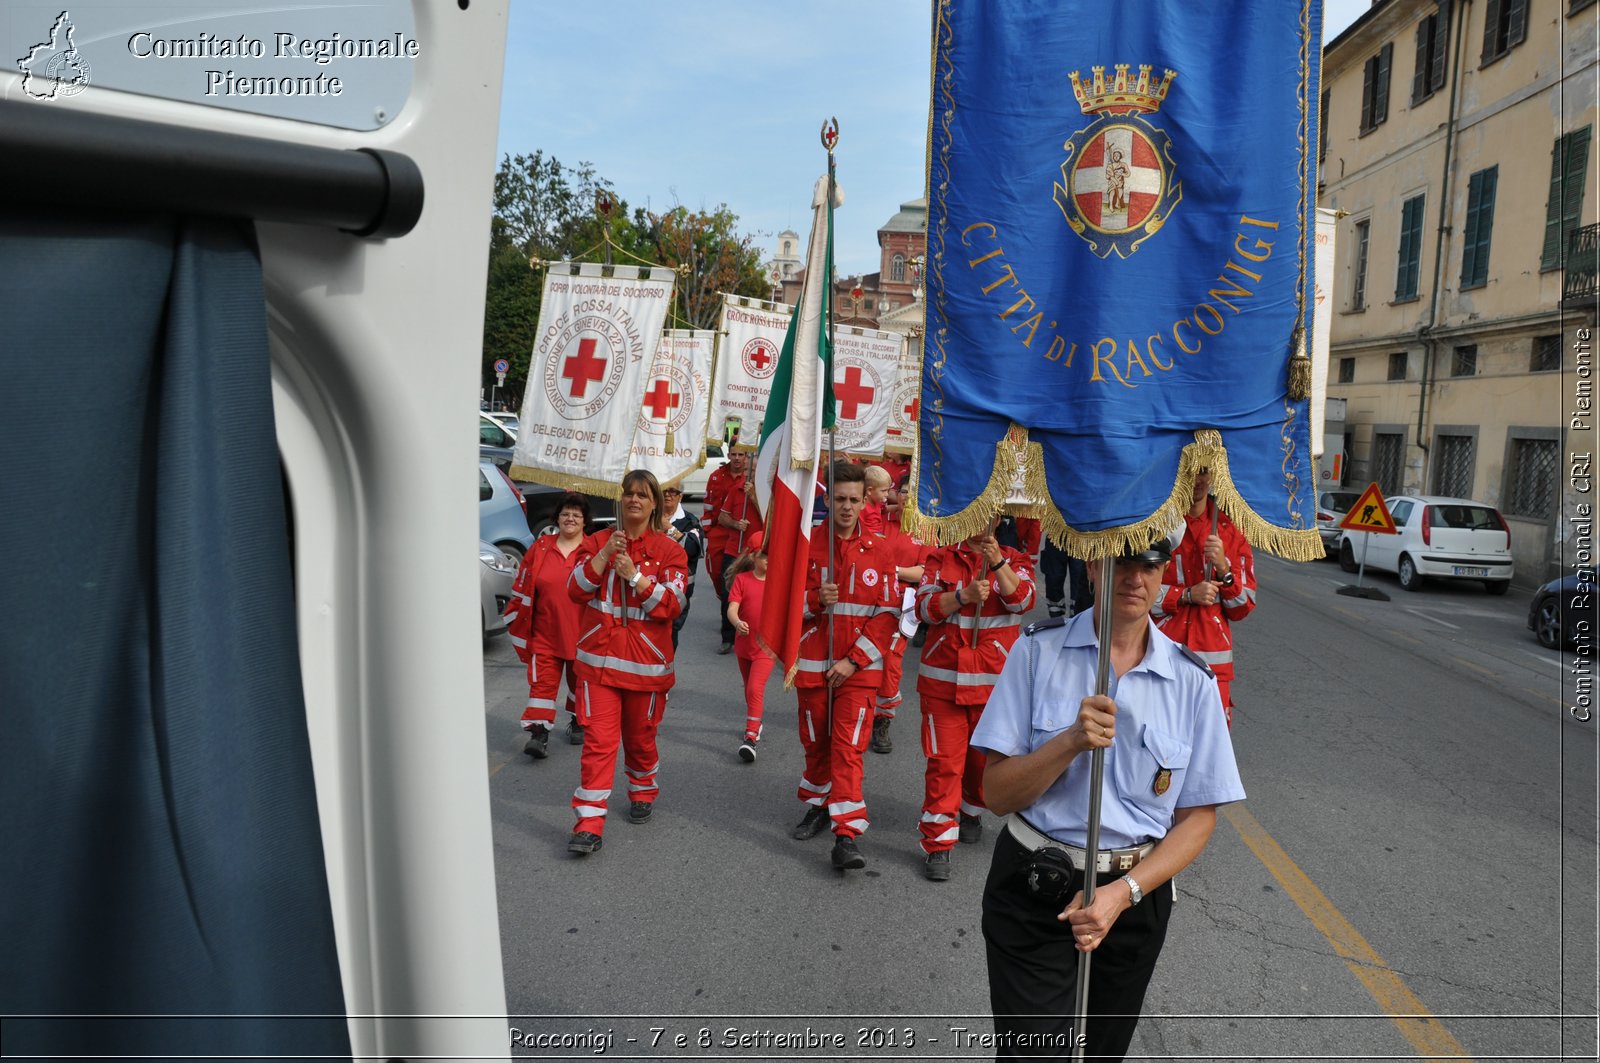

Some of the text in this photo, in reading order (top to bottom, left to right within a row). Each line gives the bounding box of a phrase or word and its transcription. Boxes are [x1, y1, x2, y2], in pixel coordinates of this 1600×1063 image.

[571, 283, 607, 296] VOLONTARI
[608, 286, 621, 297] DEL
[623, 286, 664, 299] SOCCORSO
[1043, 334, 1078, 368] DI
[1089, 214, 1280, 388] RACCONIGI
[726, 309, 787, 330] CROCE ROSSA ITAL
[539, 299, 643, 363] CROCE ROSSA ITALIANA
[839, 347, 865, 357] ROSSA
[866, 350, 898, 361] ITALIANA
[861, 342, 869, 350] DEL
[544, 318, 626, 416] CONVENZIONE DI GINEVRA 22 AGOSTO 1864
[655, 351, 706, 396] SSA ITALIANA
[727, 383, 771, 396] COMITATO LOC
[720, 400, 766, 412] SOMMARIVA DEL
[533, 423, 611, 445] DELEGAZIONE DI
[821, 436, 870, 448] EERAGNO
[544, 443, 588, 462] BARGE
[631, 445, 693, 458] AVIGLNO
